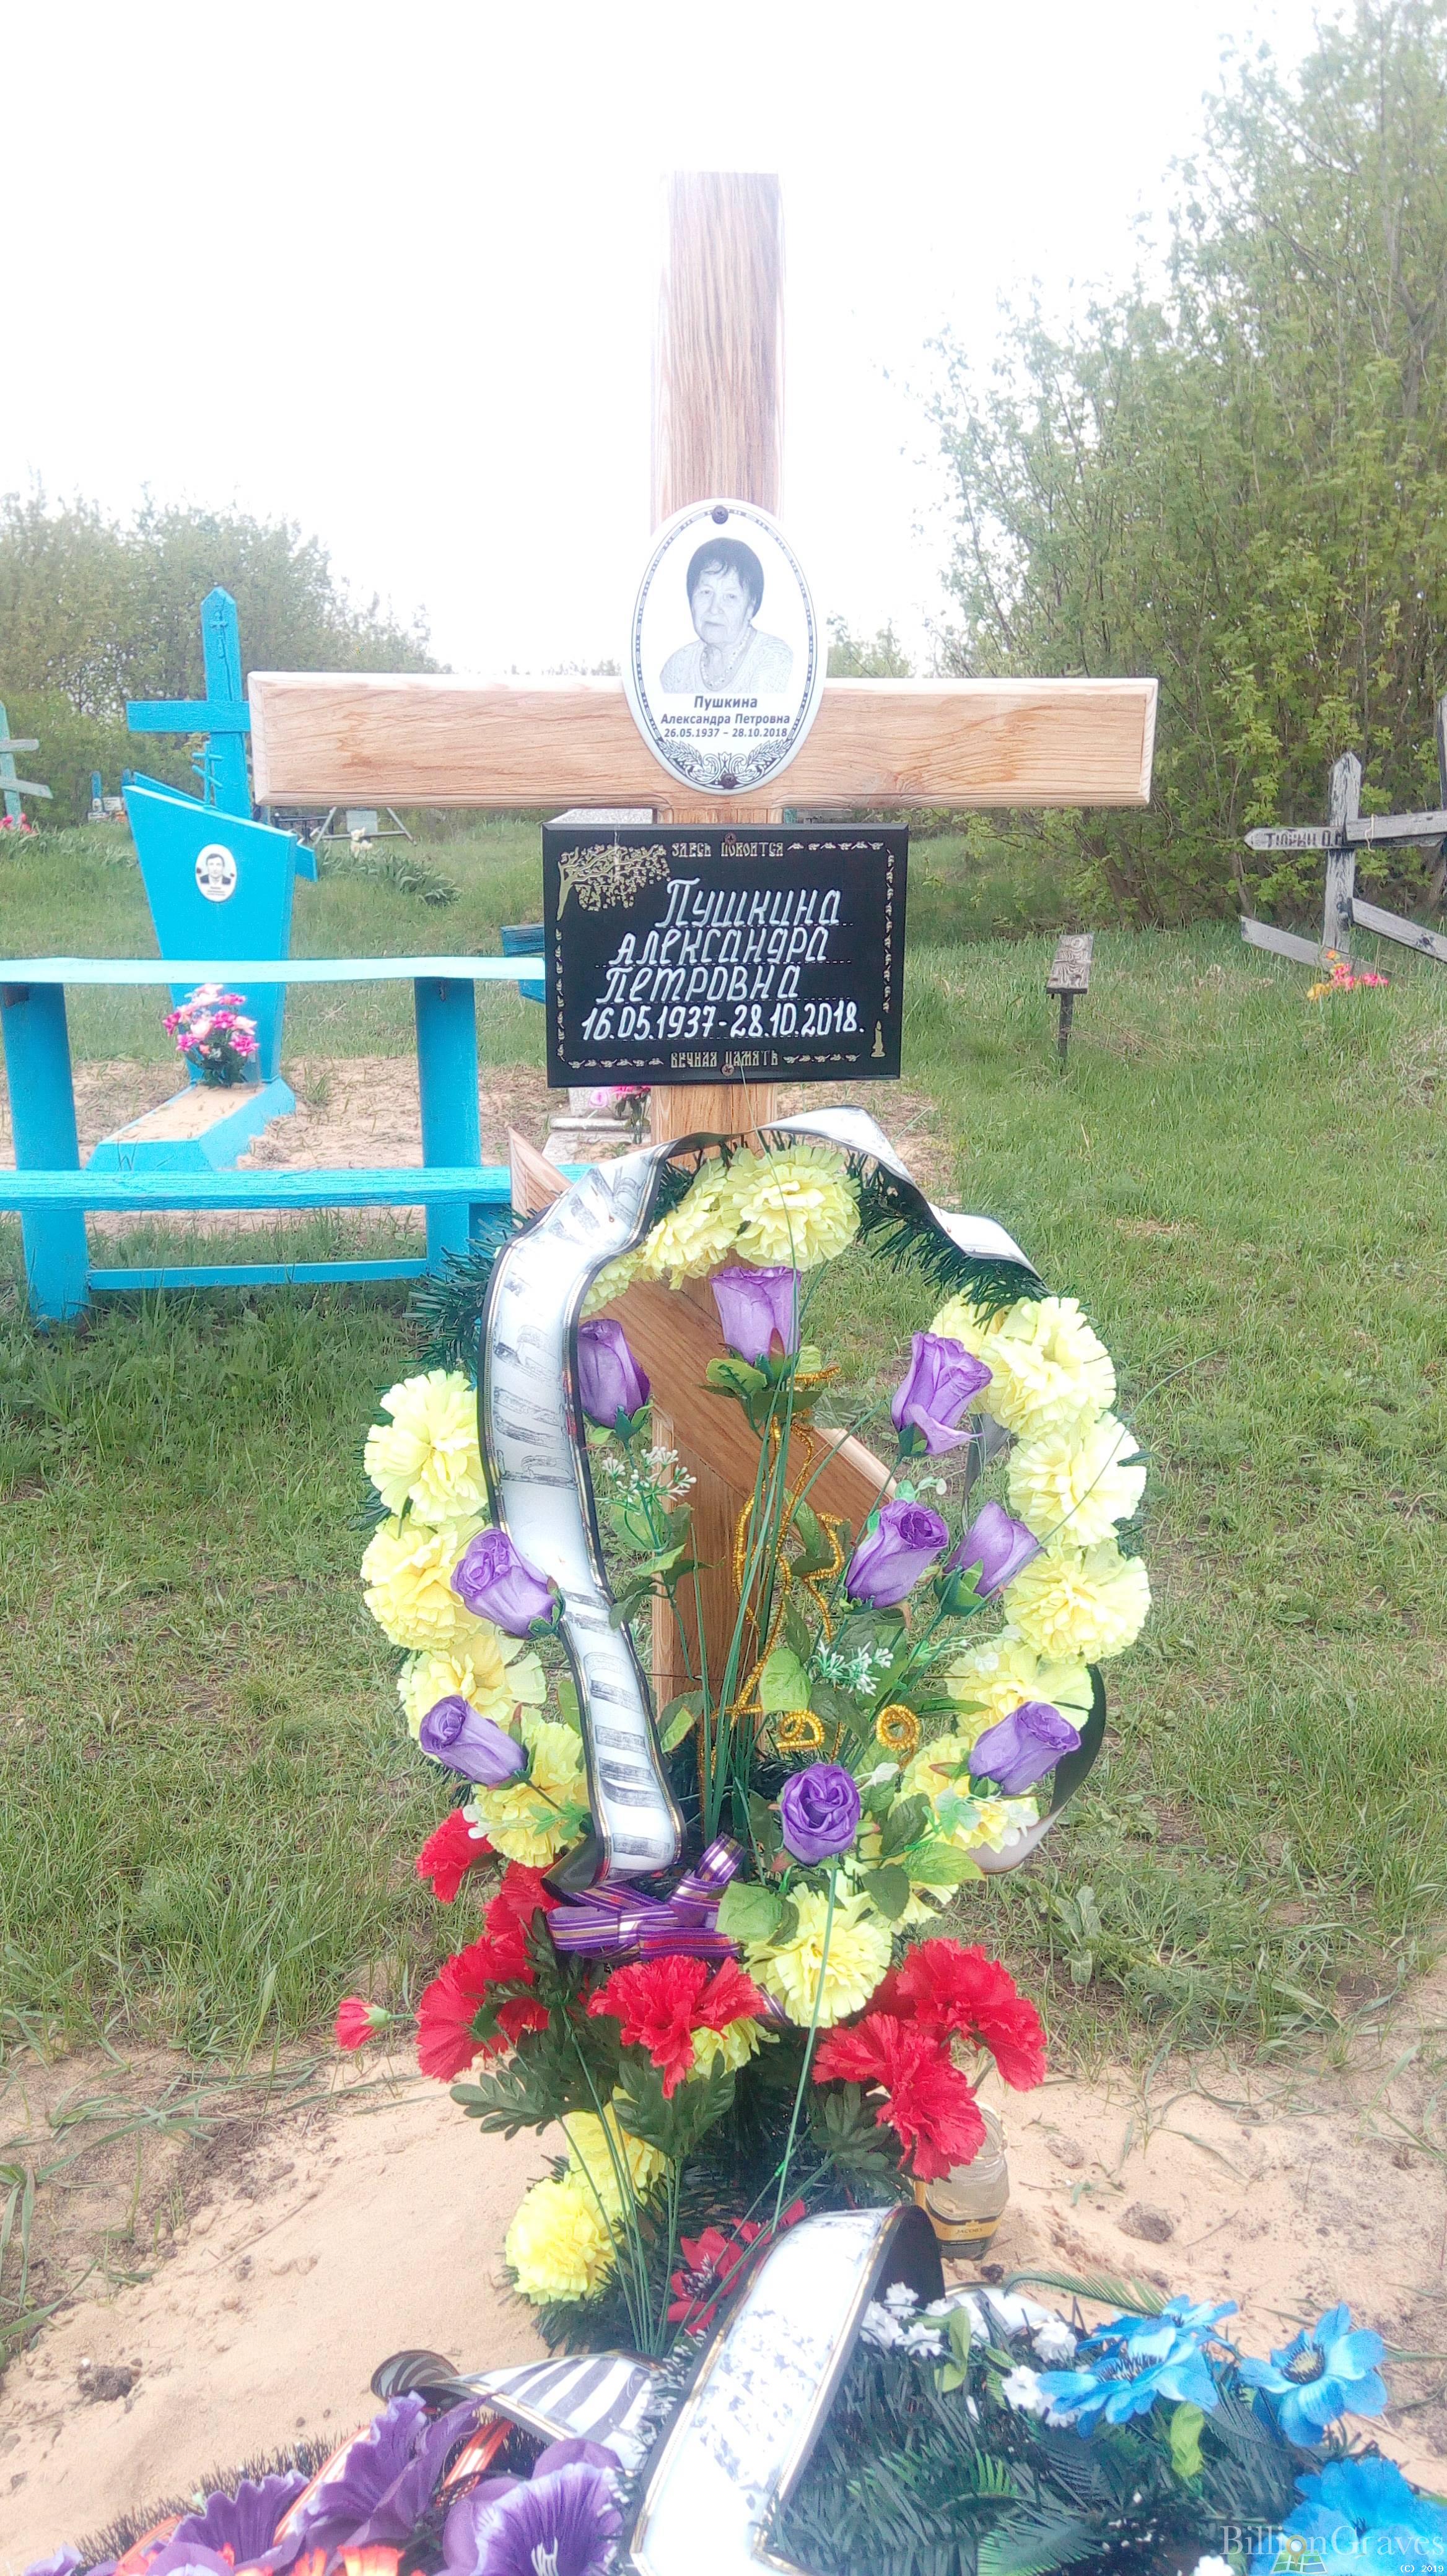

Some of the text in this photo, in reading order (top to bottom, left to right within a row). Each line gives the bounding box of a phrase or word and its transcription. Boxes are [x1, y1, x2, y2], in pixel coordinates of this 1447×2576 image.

[694, 695, 758, 710] Пушкина
[660, 714, 790, 726] Александра Петровна
[664, 728, 720, 738] 26.05.1937
[732, 728, 787, 738] 28.10.2018
[671, 842, 711, 858] ЗДЕСЬ
[670, 1050, 778, 1068] ВЕЧНАЯ ПАМЯТЬ
